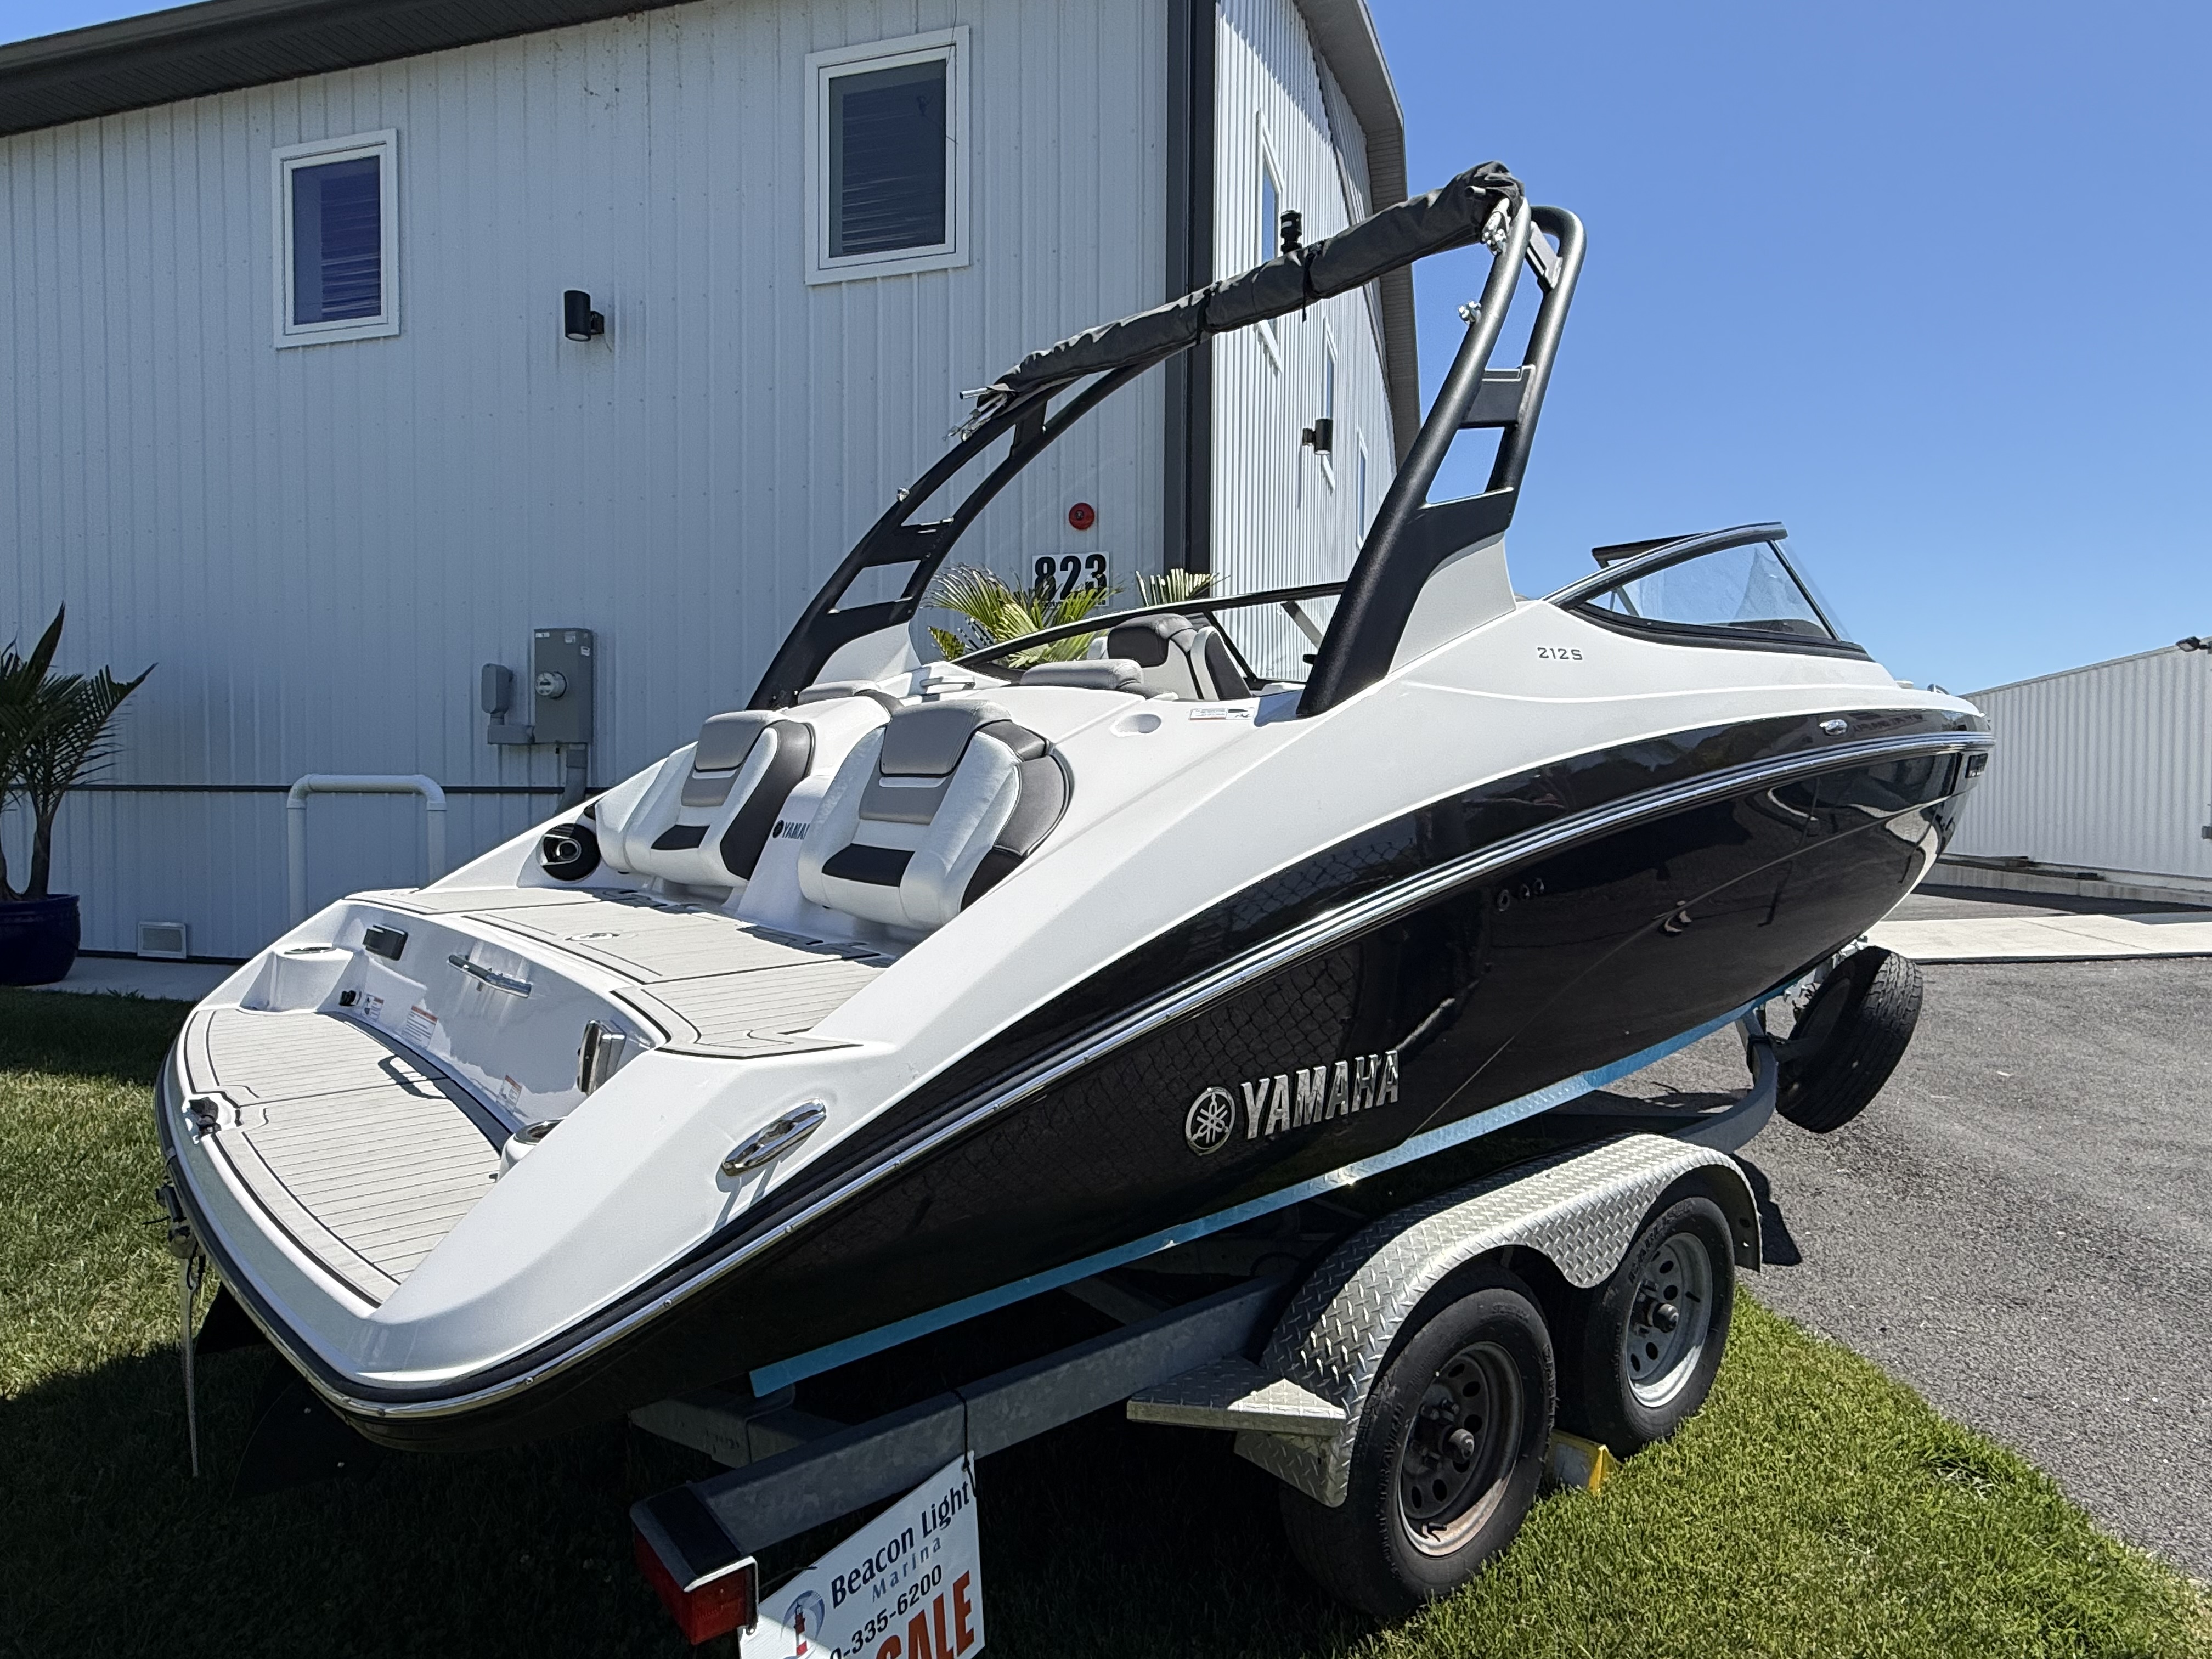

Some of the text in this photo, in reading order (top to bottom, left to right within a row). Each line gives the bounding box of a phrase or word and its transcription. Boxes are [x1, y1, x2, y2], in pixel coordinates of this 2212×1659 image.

[1035, 554, 1107, 602] 823
[1537, 647, 1582, 660] 212S
[1241, 1050, 1398, 1139] YAMAHA
[831, 1481, 970, 1609] Beacon Light
[872, 1537, 941, 1602] Marina
[876, 1570, 975, 1659] ALE
